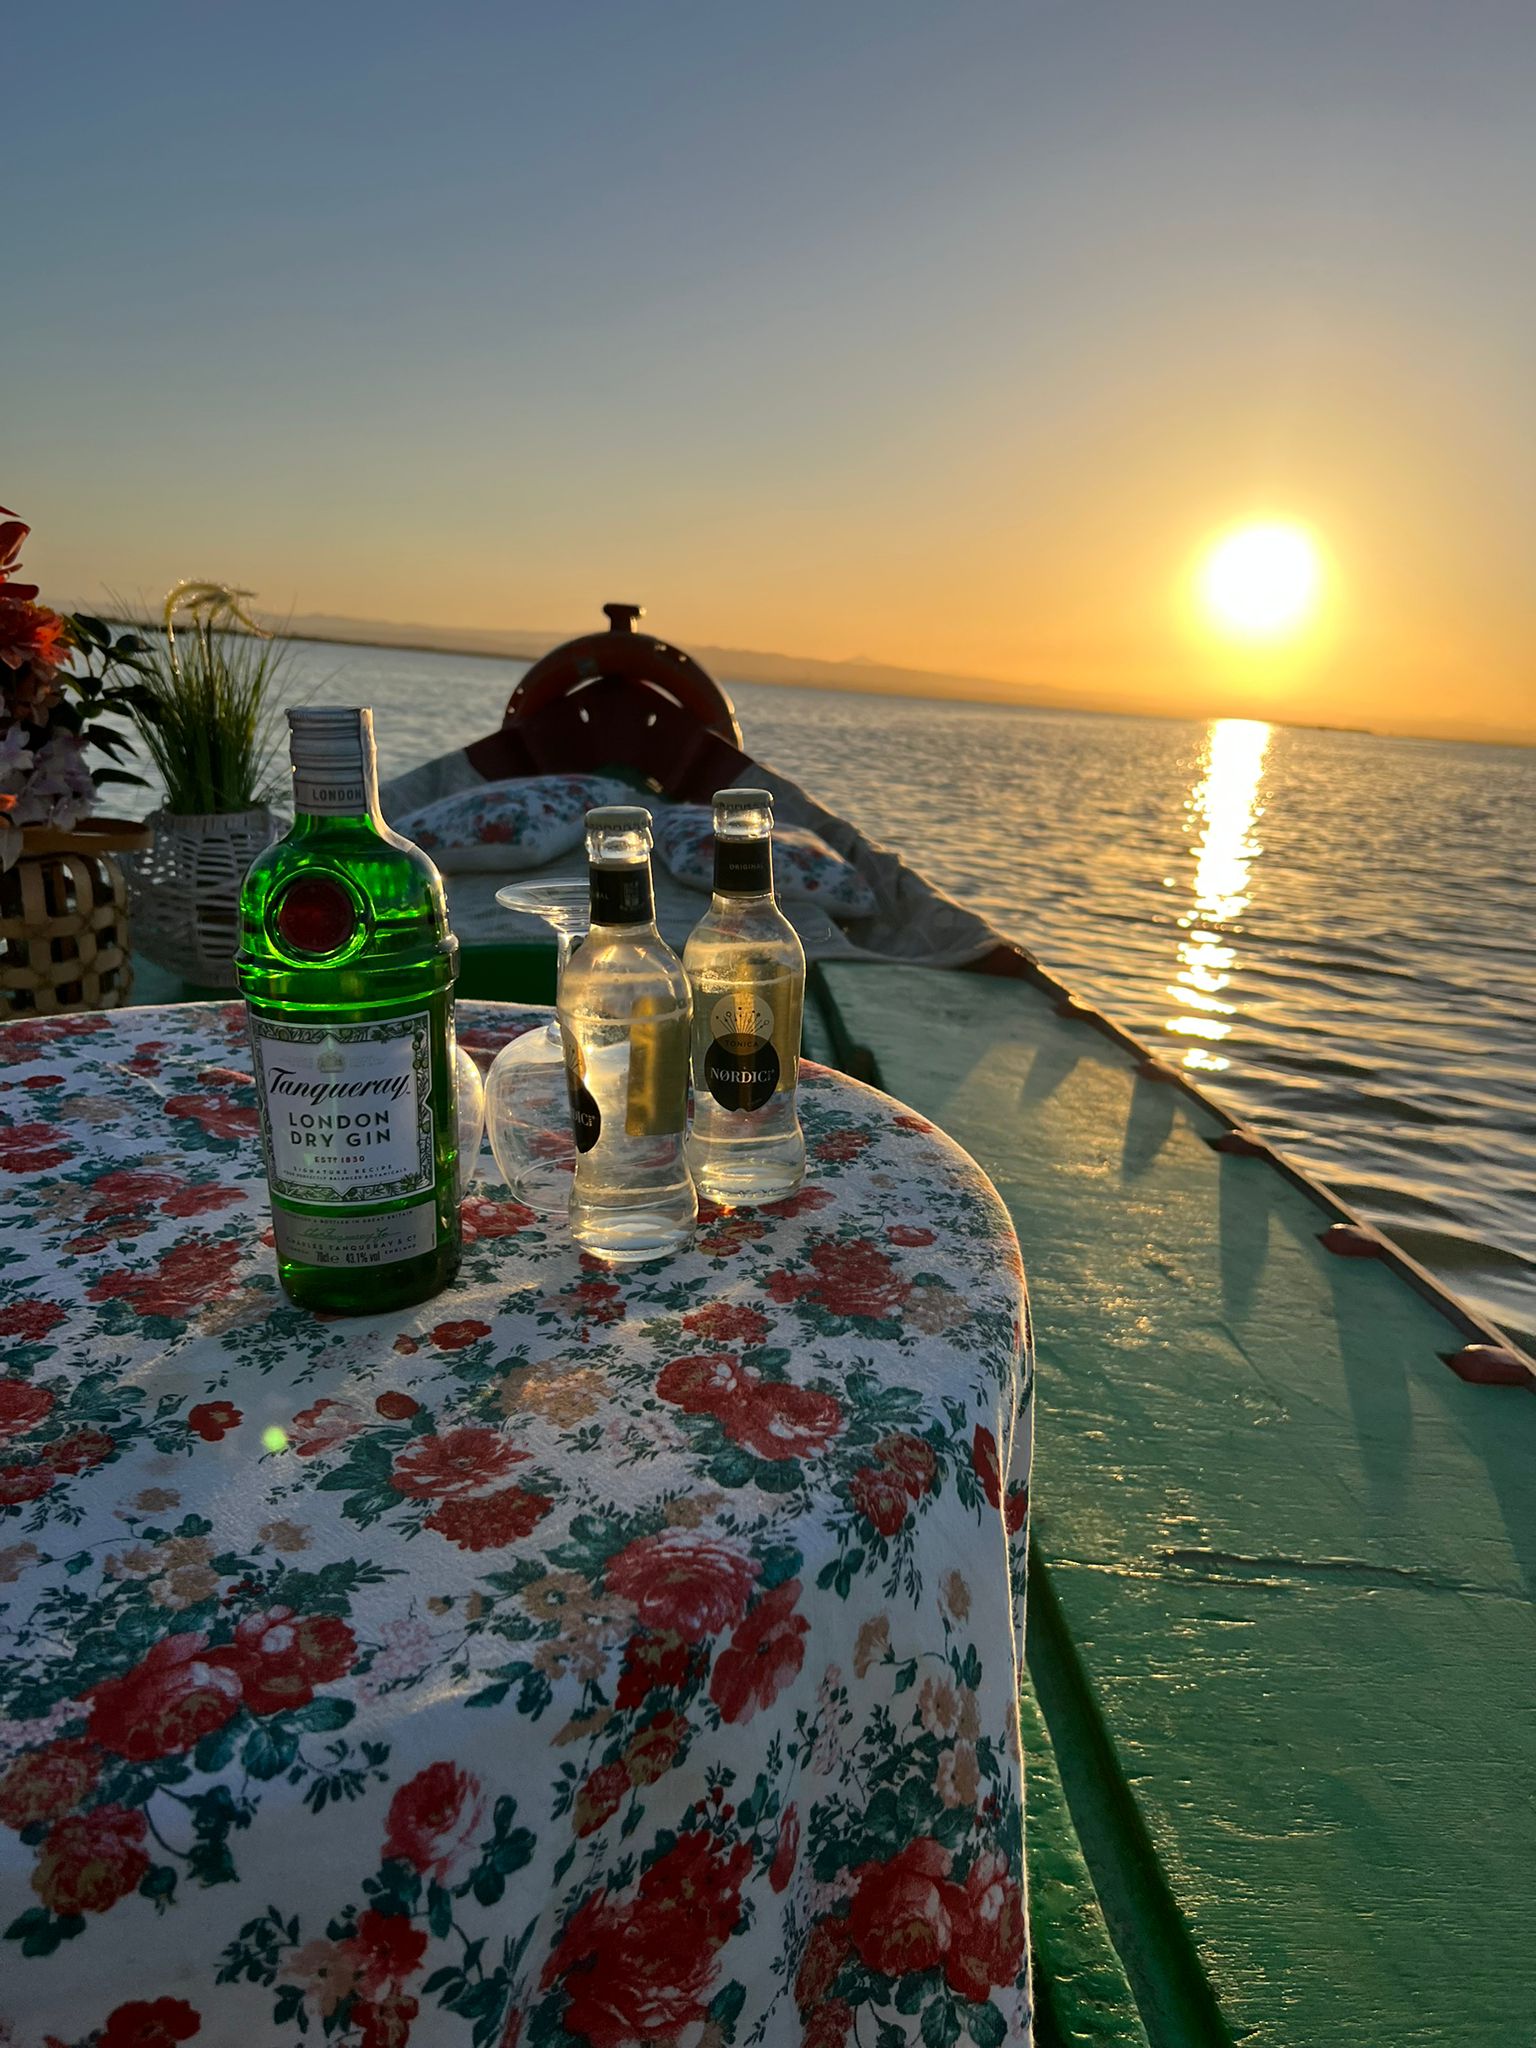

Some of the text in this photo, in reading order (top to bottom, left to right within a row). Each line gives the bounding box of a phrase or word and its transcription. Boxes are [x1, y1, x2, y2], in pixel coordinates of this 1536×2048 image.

[312, 789, 362, 801] LONDON
[268, 1067, 410, 1106] Tanqueray
[289, 1110, 389, 1129] LONDON
[290, 1129, 391, 1148] DRY GIN
[340, 1155, 366, 1164] 1830
[355, 1164, 392, 1174] RECIPE
[329, 1239, 393, 1251] TANQUERAY
[369, 1251, 381, 1263] vol
